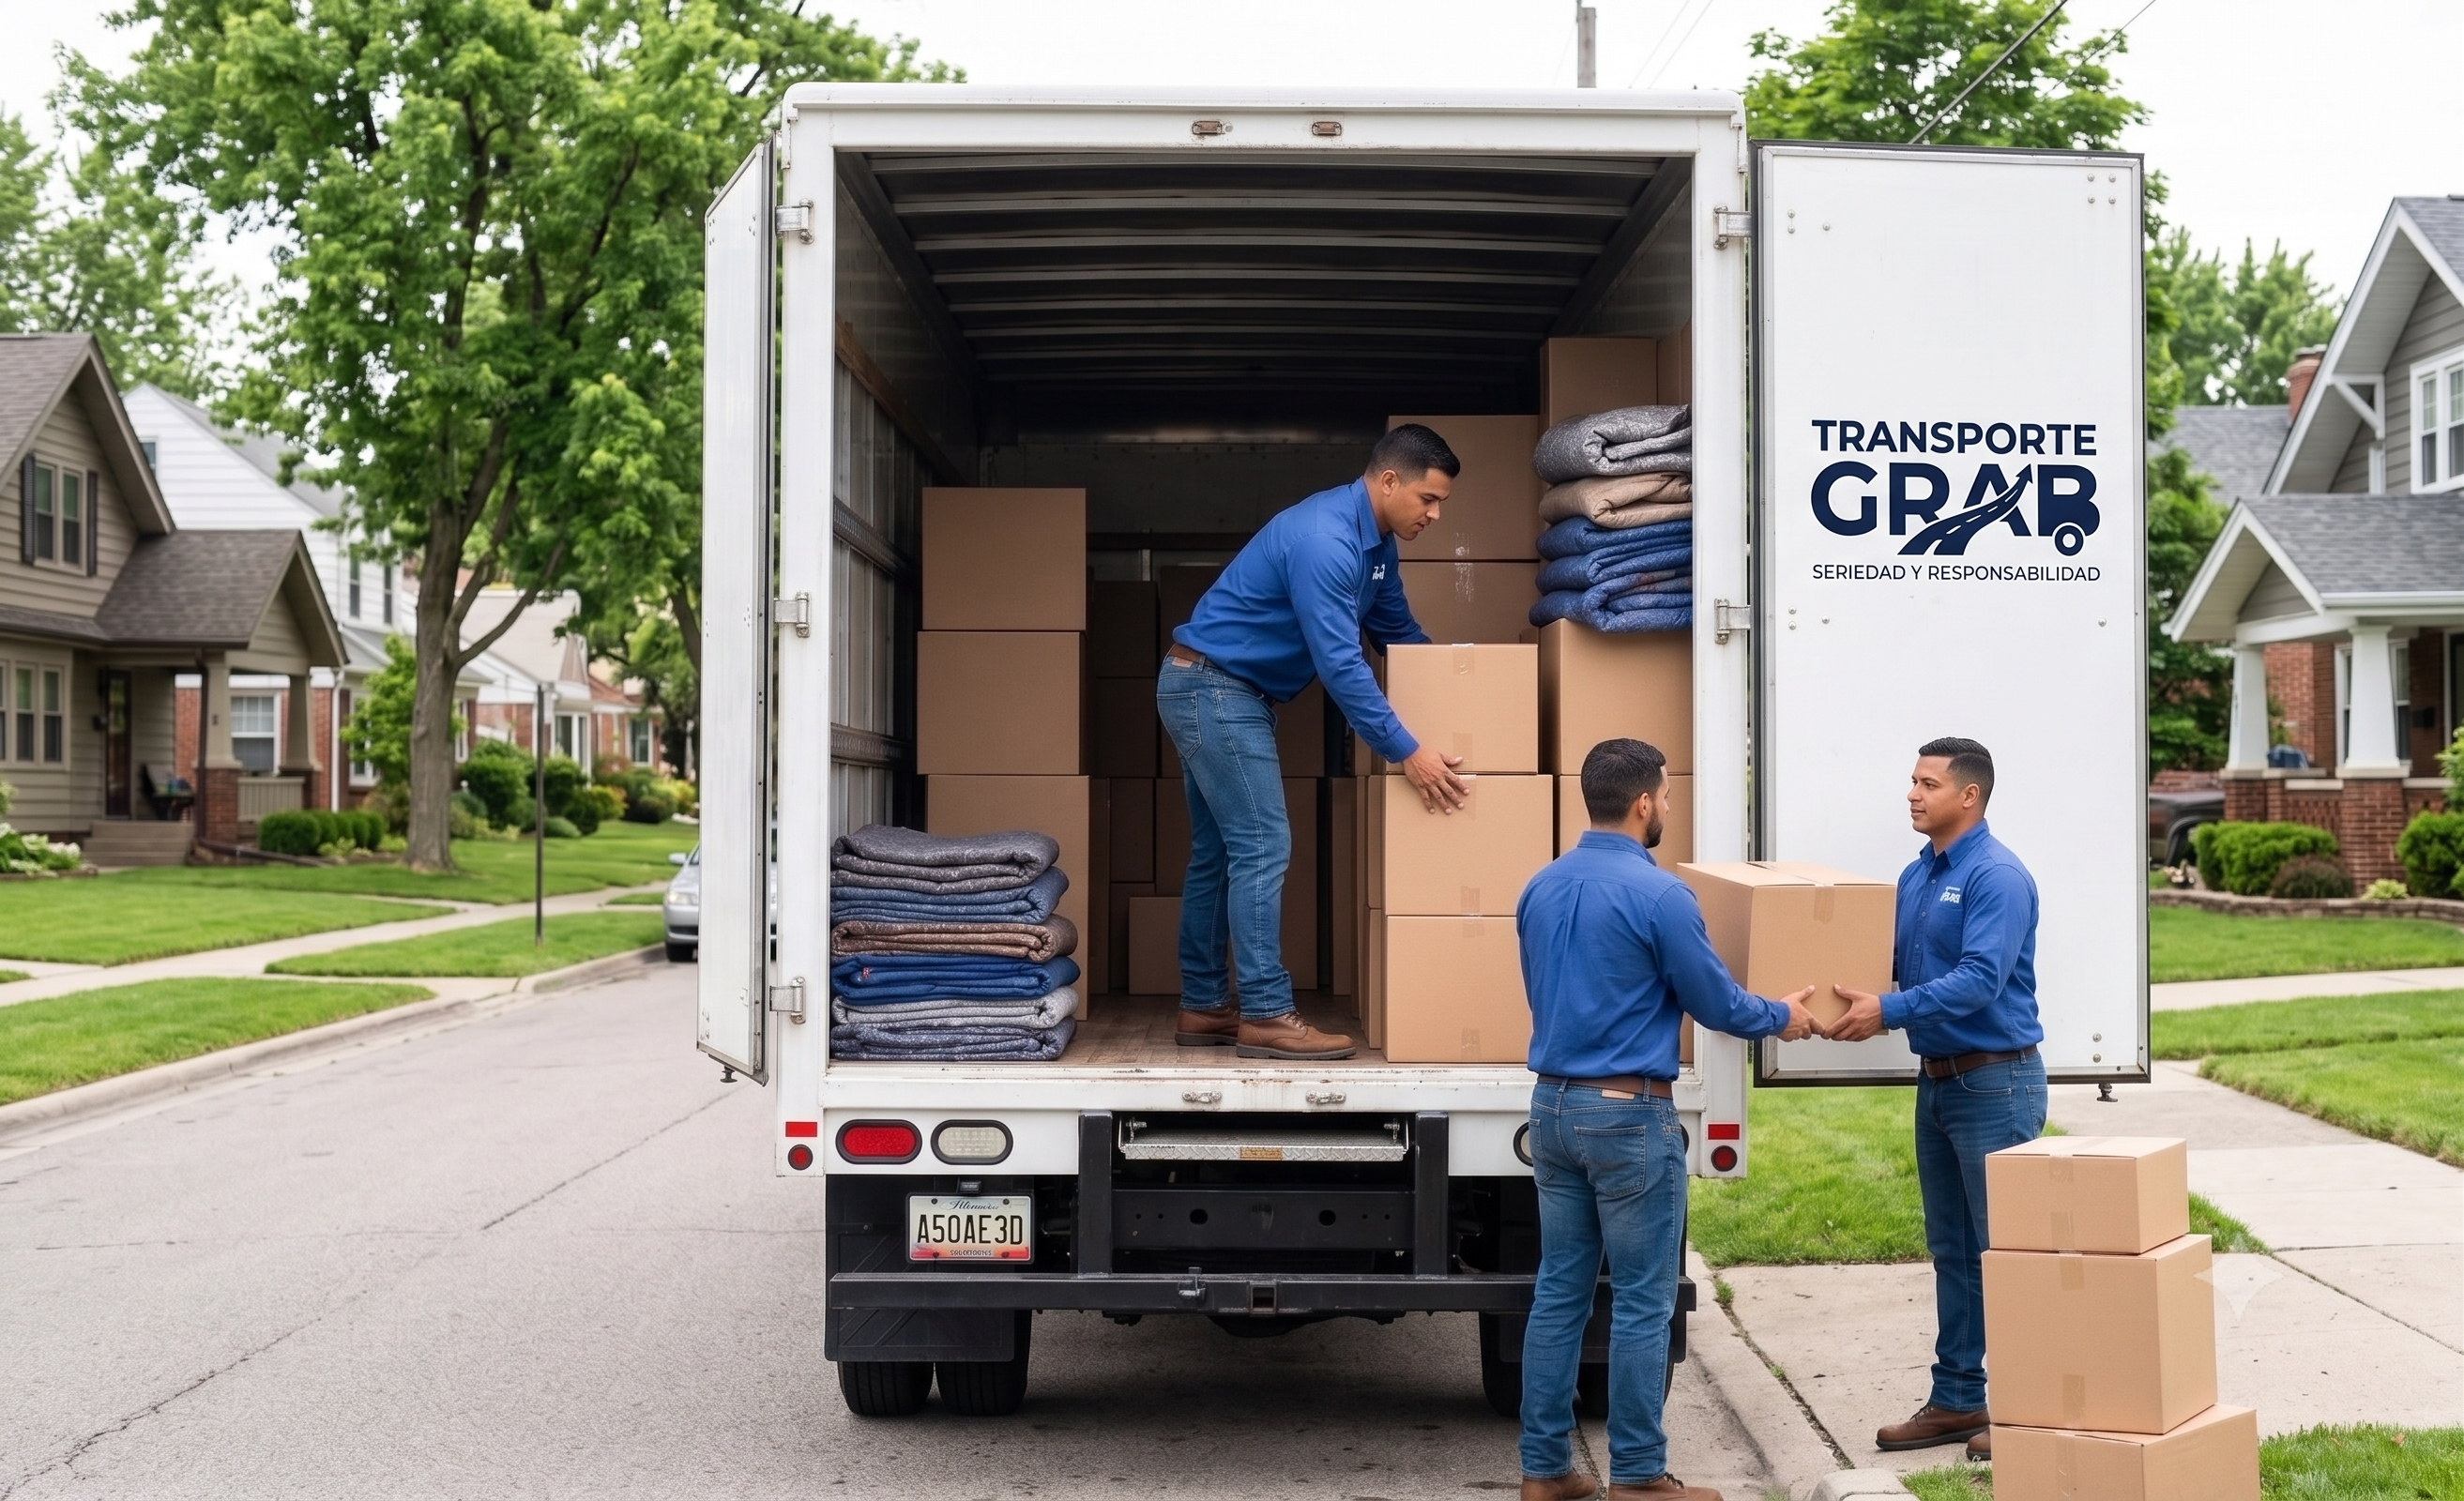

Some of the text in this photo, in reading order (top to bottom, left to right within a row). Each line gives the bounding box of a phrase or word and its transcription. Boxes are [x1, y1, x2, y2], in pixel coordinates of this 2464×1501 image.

[1812, 419, 2097, 456] TRANSPORTE
[1811, 461, 2101, 556] GRAB
[1812, 564, 2101, 582] SERIEDAD Y RESPONSABILIDAD
